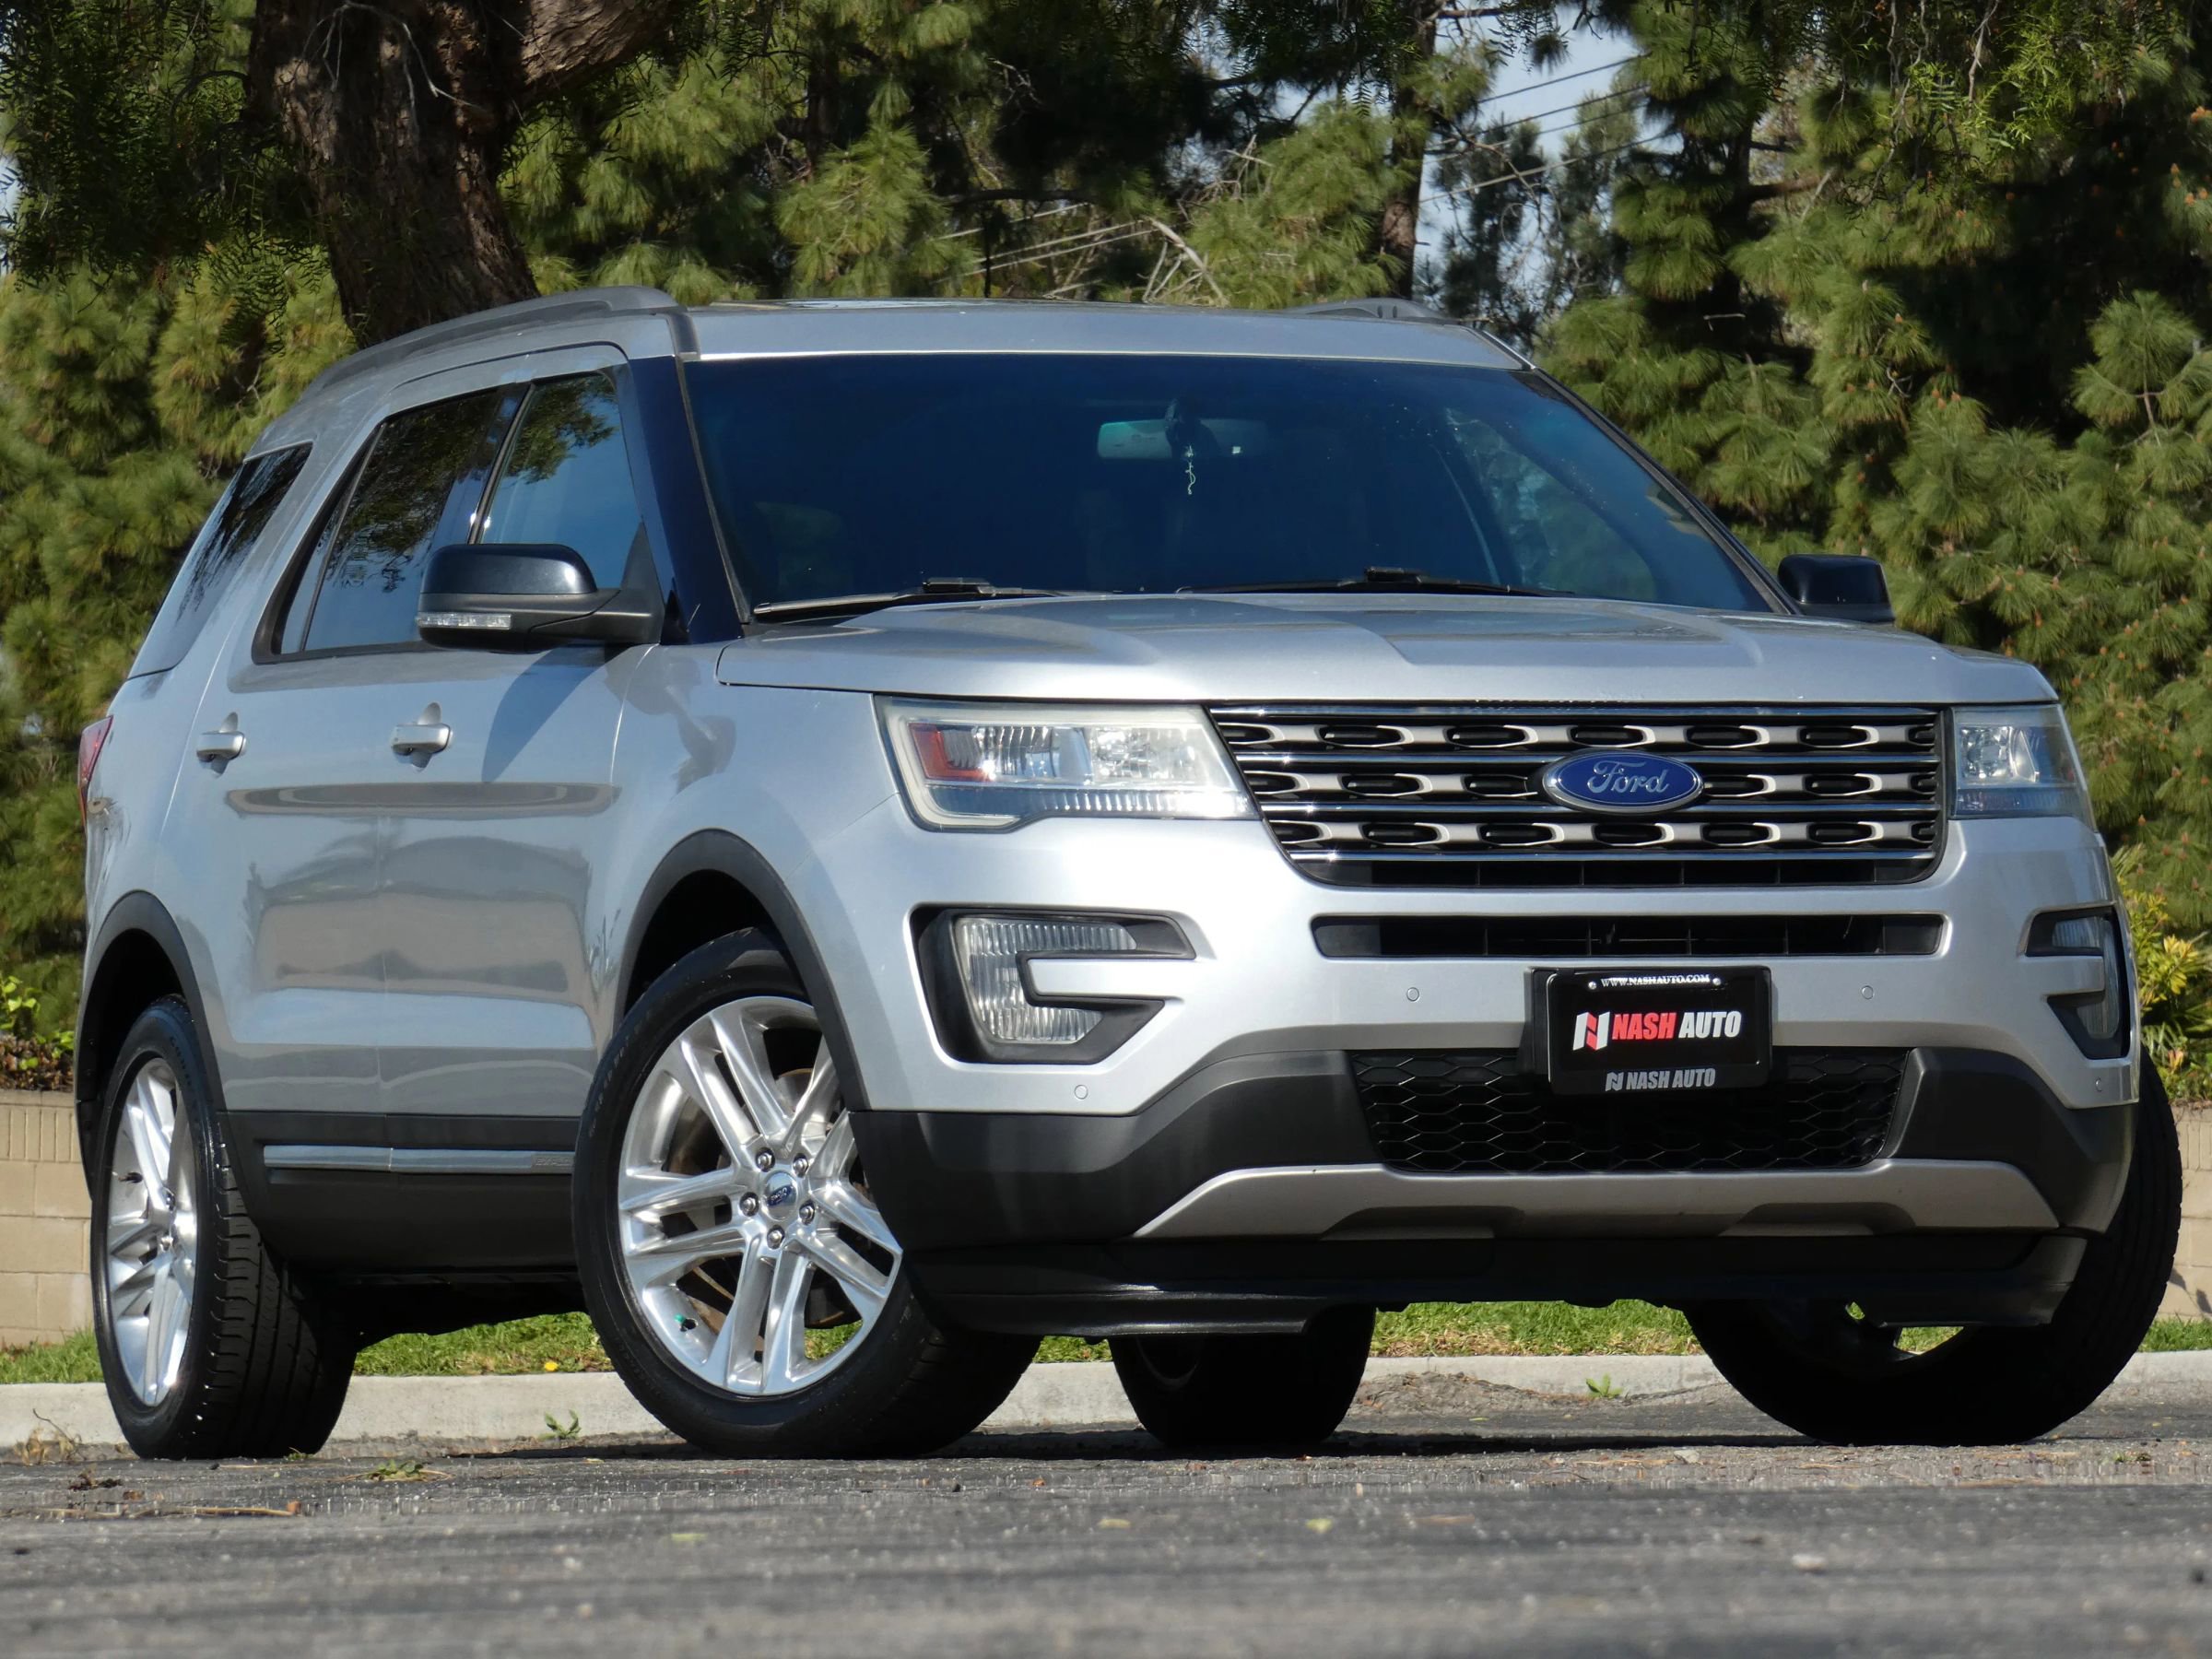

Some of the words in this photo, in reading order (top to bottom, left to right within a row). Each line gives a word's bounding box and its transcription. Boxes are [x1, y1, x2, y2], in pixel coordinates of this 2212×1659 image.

[1587, 759, 1670, 794] Ford
[1600, 974, 1711, 987] WWW.NASHAUTO.COM
[1612, 1012, 1677, 1041] NASH
[1677, 1010, 1742, 1039] AUTO
[1626, 1069, 1670, 1090] NASH
[1671, 1067, 1716, 1088] AUTO
